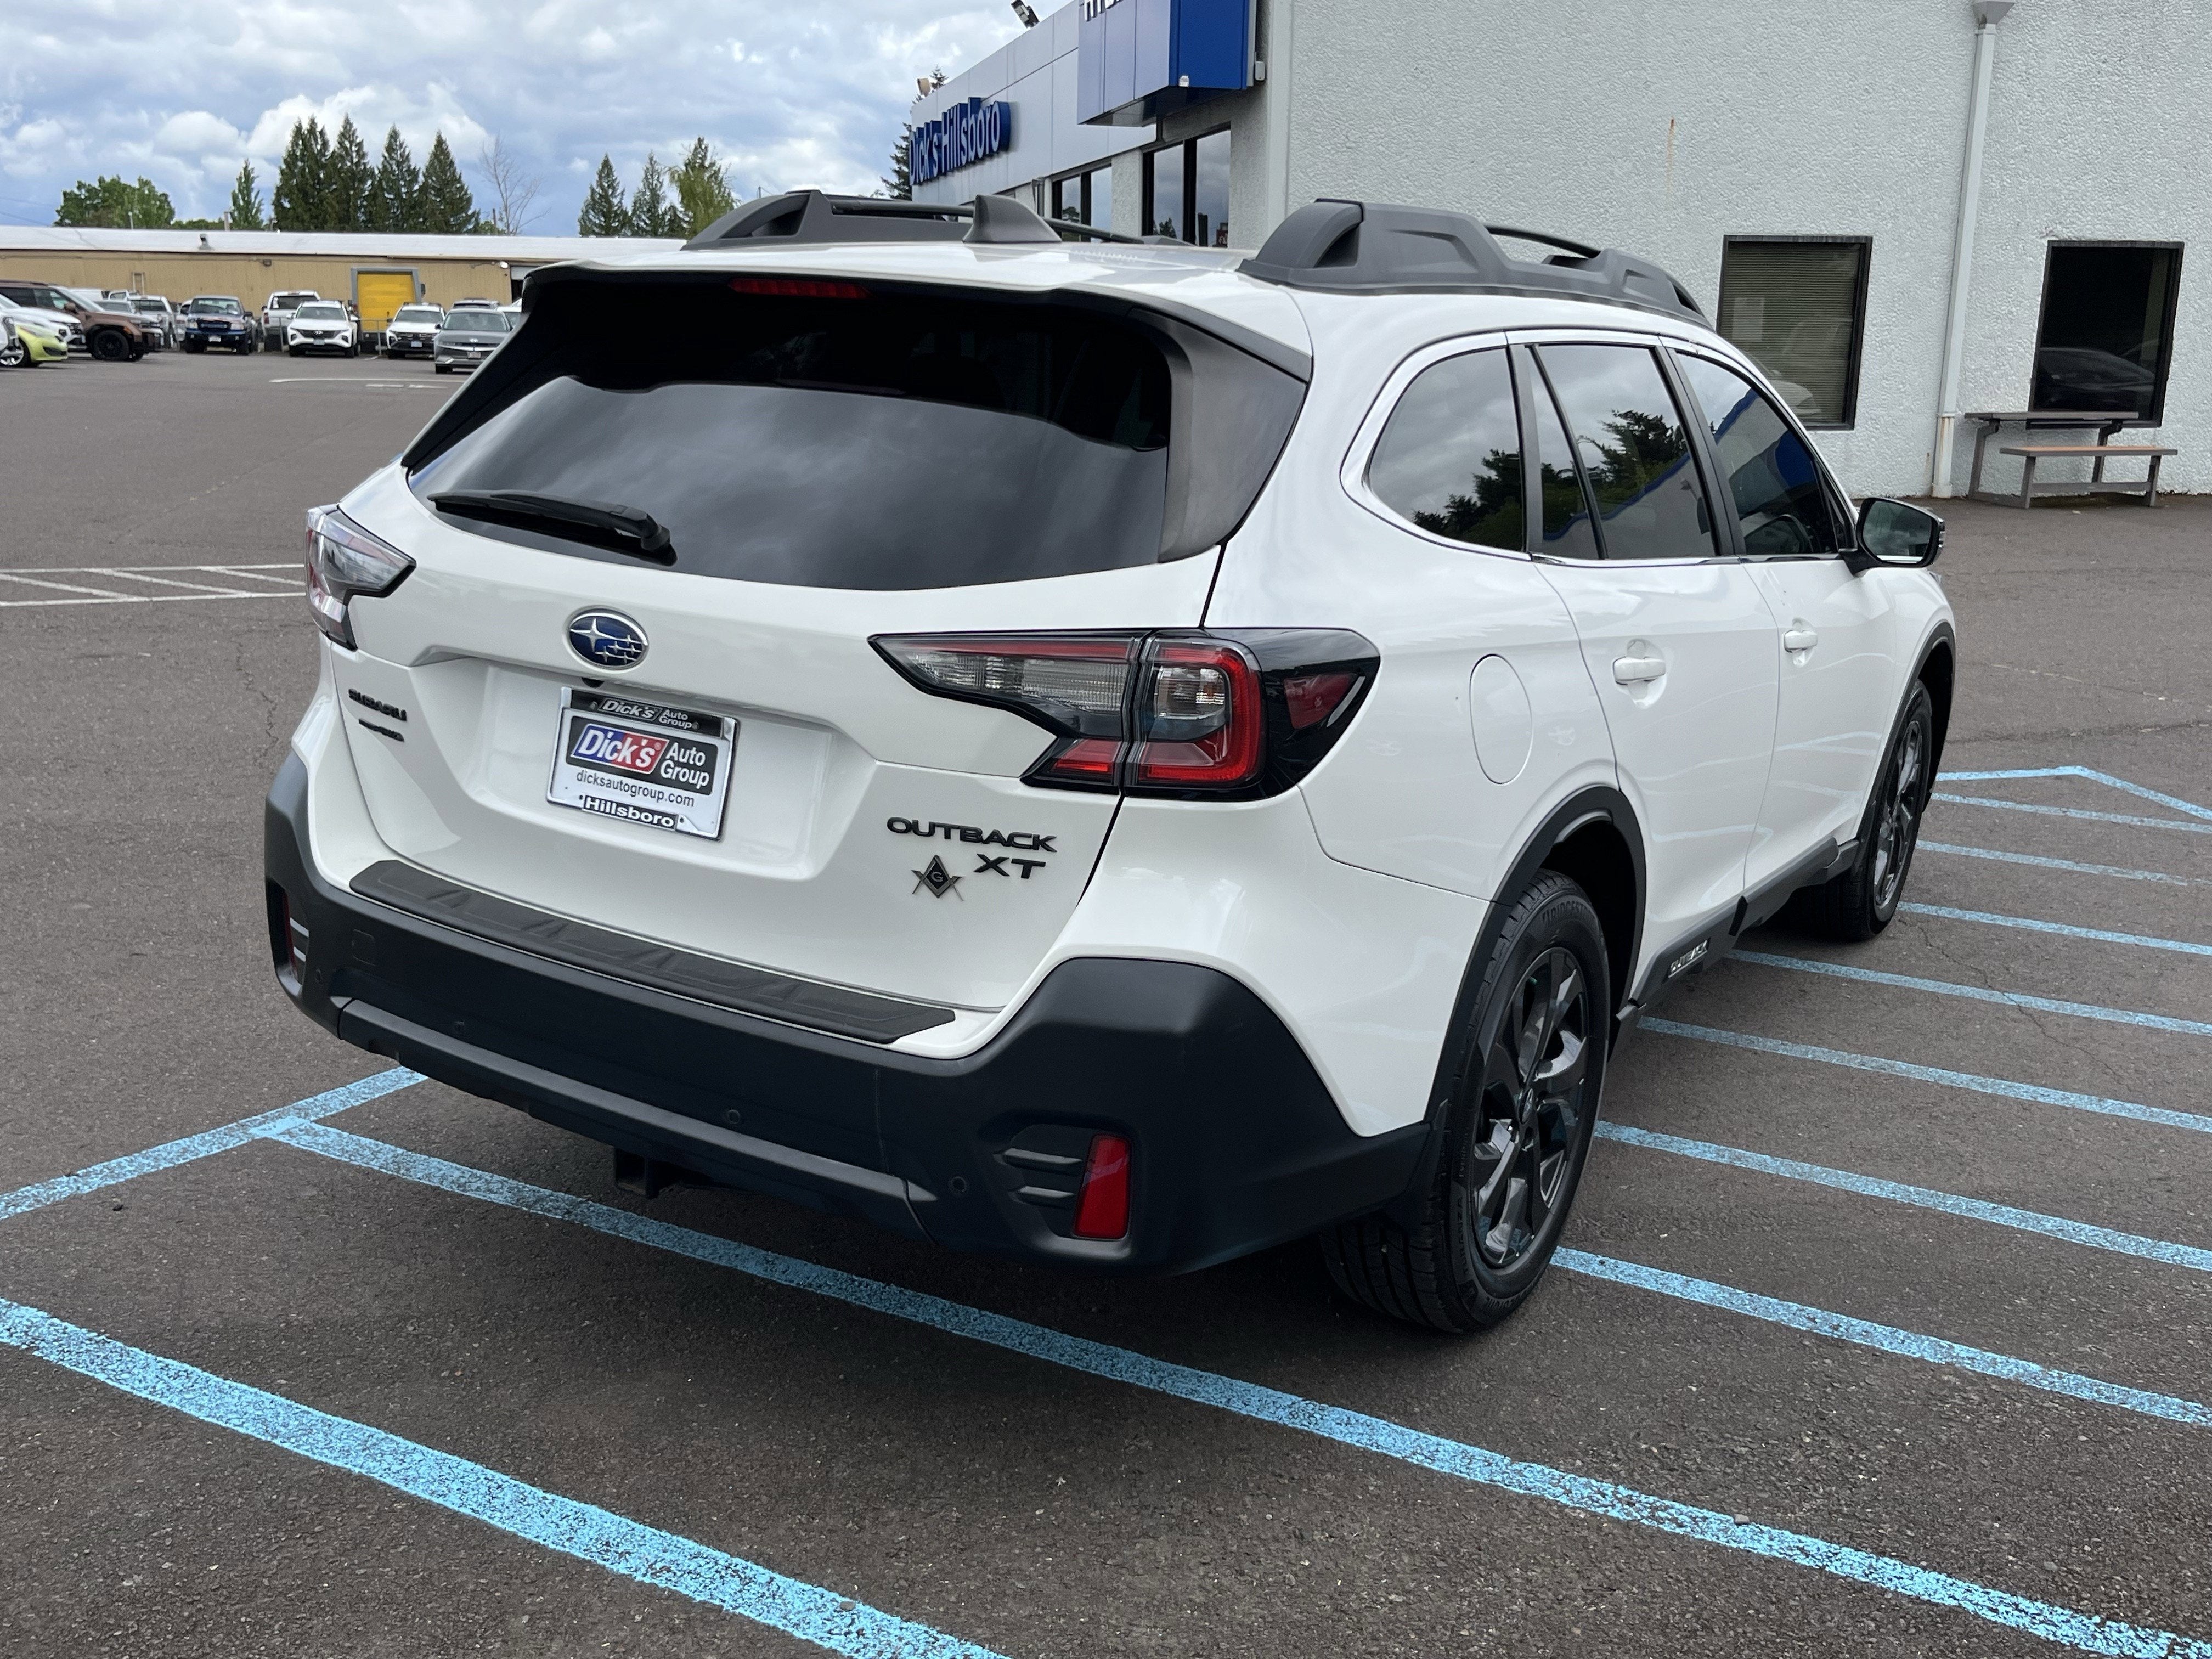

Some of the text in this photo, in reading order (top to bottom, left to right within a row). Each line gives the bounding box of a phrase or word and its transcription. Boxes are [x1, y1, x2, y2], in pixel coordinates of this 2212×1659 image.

[909, 97, 1003, 185] Dick's Hillsboro
[602, 699, 657, 719] Dick's
[658, 715, 692, 730] Group
[663, 709, 689, 720] Auto
[578, 729, 656, 769] Dick's
[665, 742, 706, 766] Auto
[661, 759, 709, 789] Group
[575, 770, 695, 807] dicksautogroup.com
[585, 795, 675, 828] Hillsboro
[887, 816, 1058, 853] OUTBACK
[930, 871, 944, 883] G
[973, 853, 1047, 879] XT
